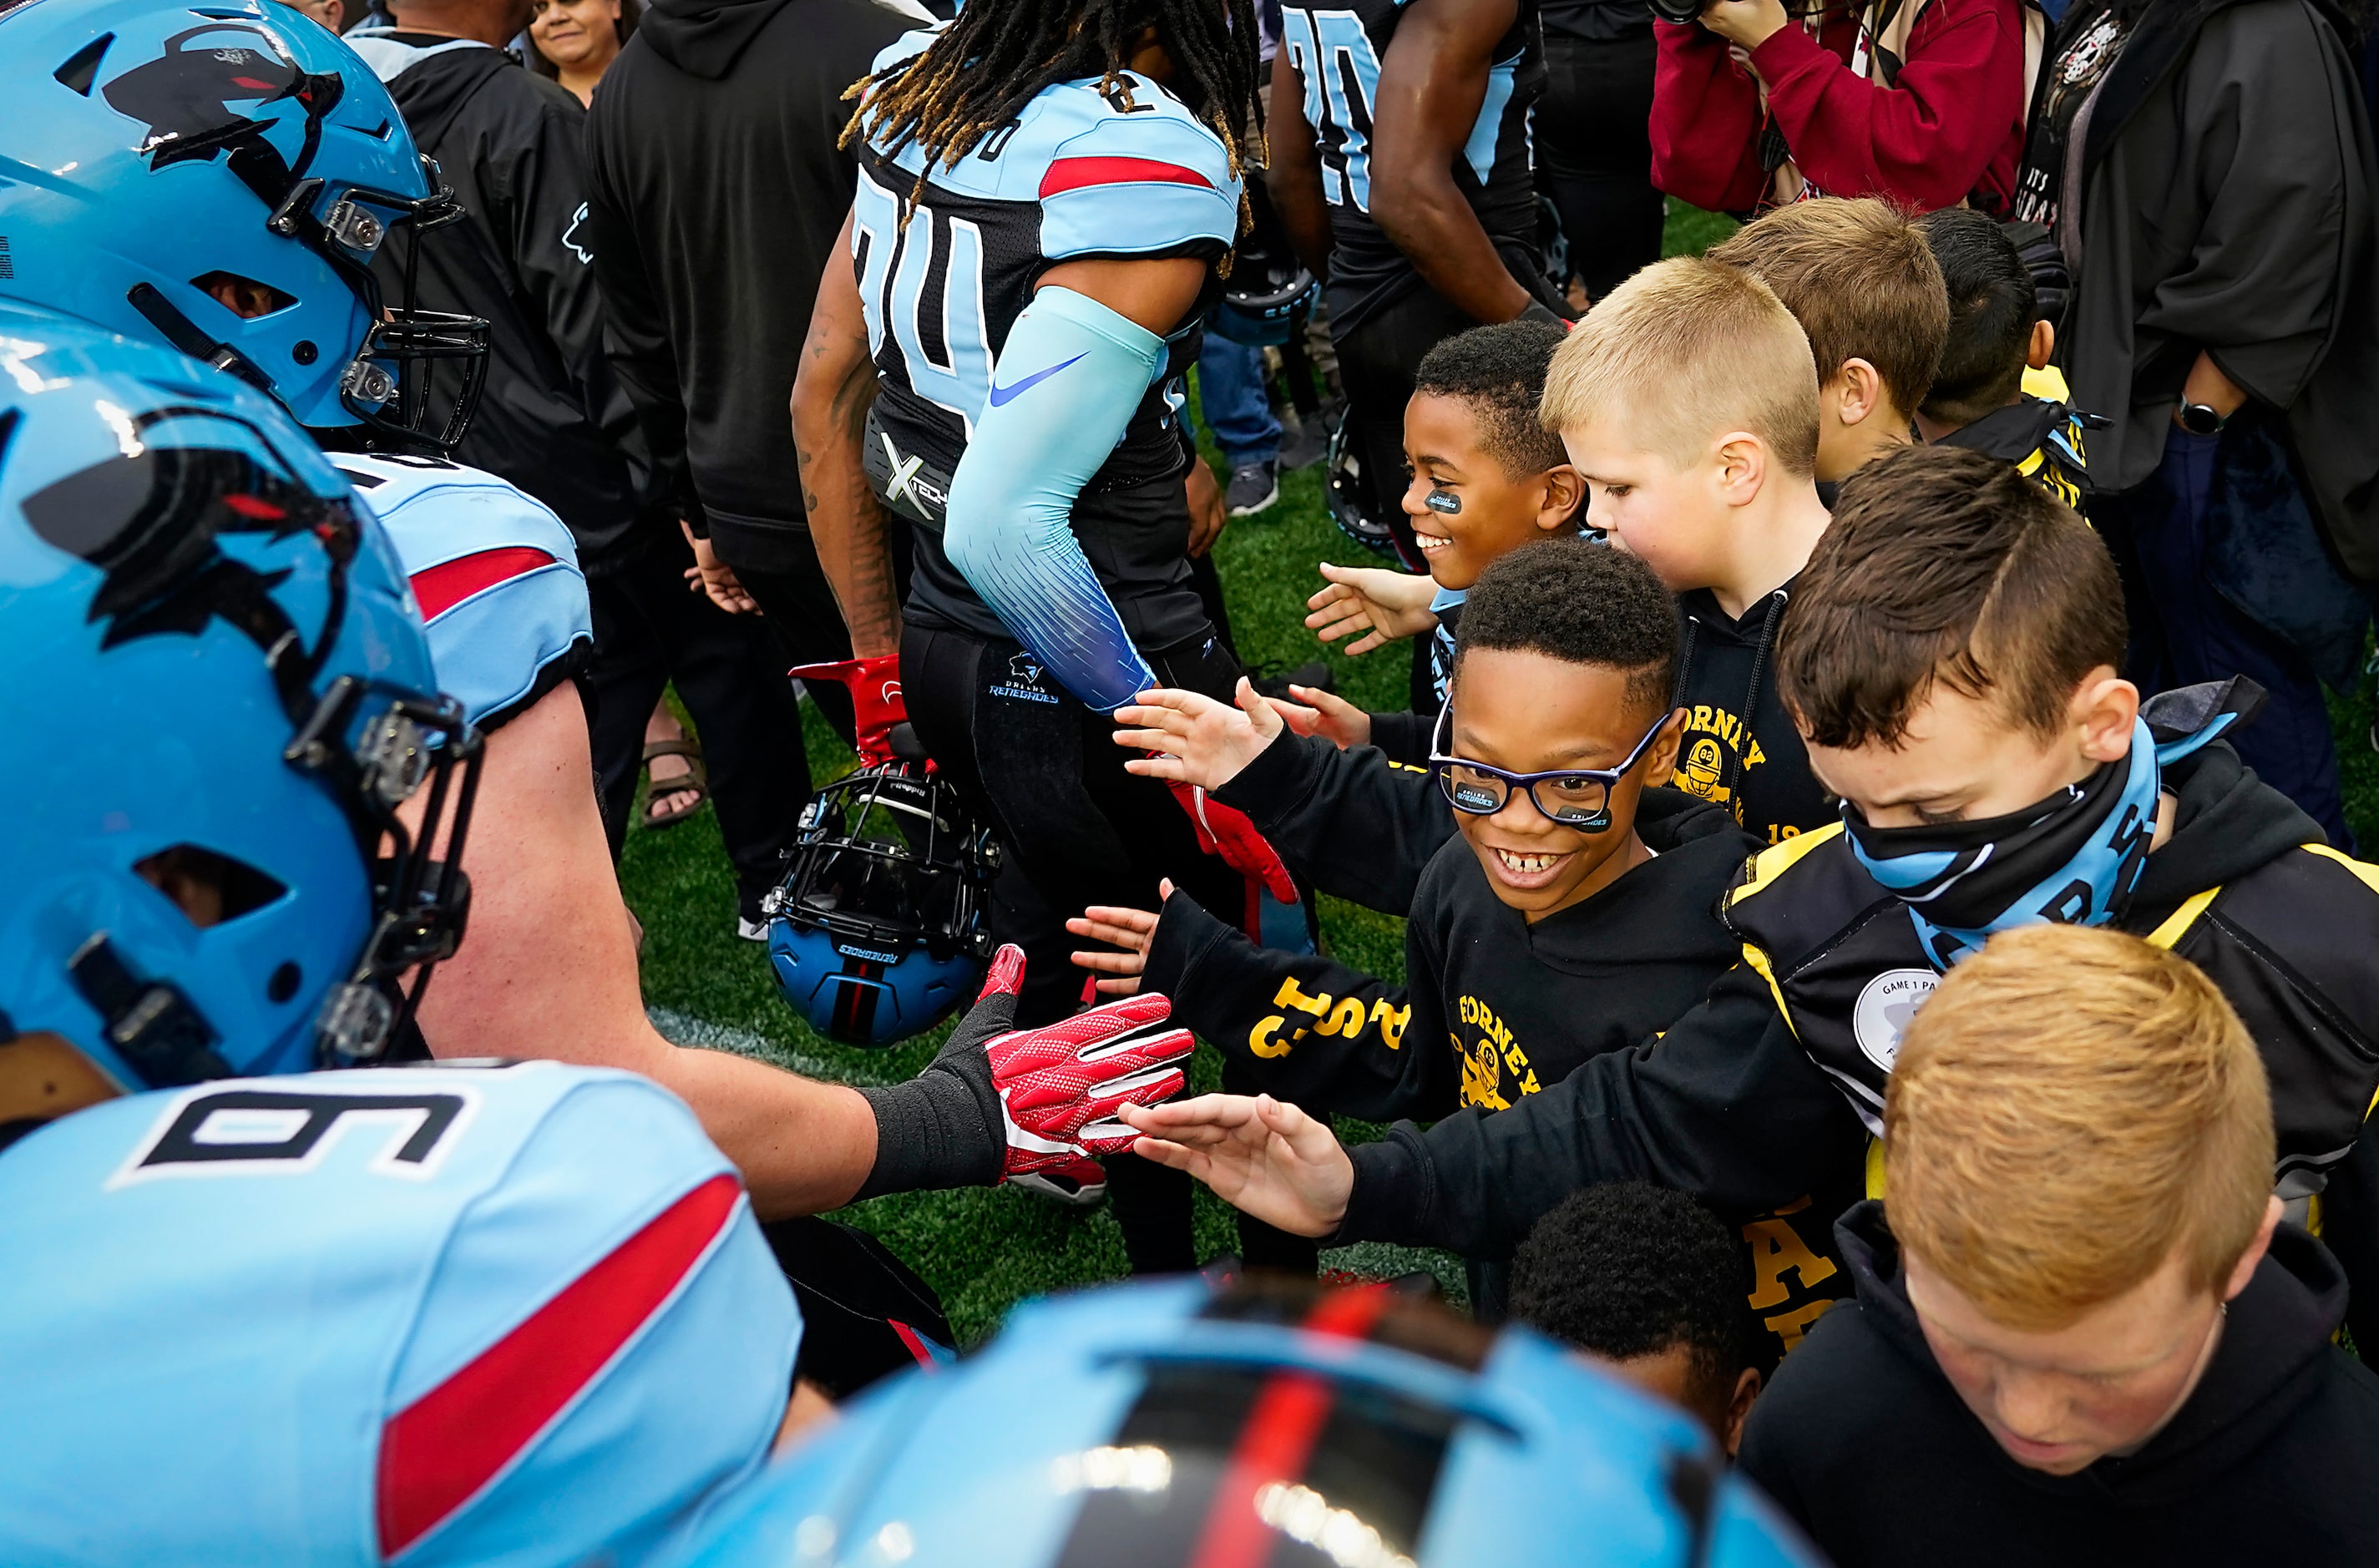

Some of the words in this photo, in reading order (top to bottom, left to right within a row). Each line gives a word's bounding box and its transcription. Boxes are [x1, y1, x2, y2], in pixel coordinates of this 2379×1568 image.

[989, 685, 1059, 704] RENEGADES
[1682, 705, 1767, 771] ORNEY
[1699, 748, 1713, 761] 82
[838, 944, 898, 964] RENEGADES
[1882, 980, 1910, 994] GAME
[1913, 981, 1918, 989] 1
[1922, 981, 1936, 991] PA
[1459, 994, 1541, 1096] FORNEY
